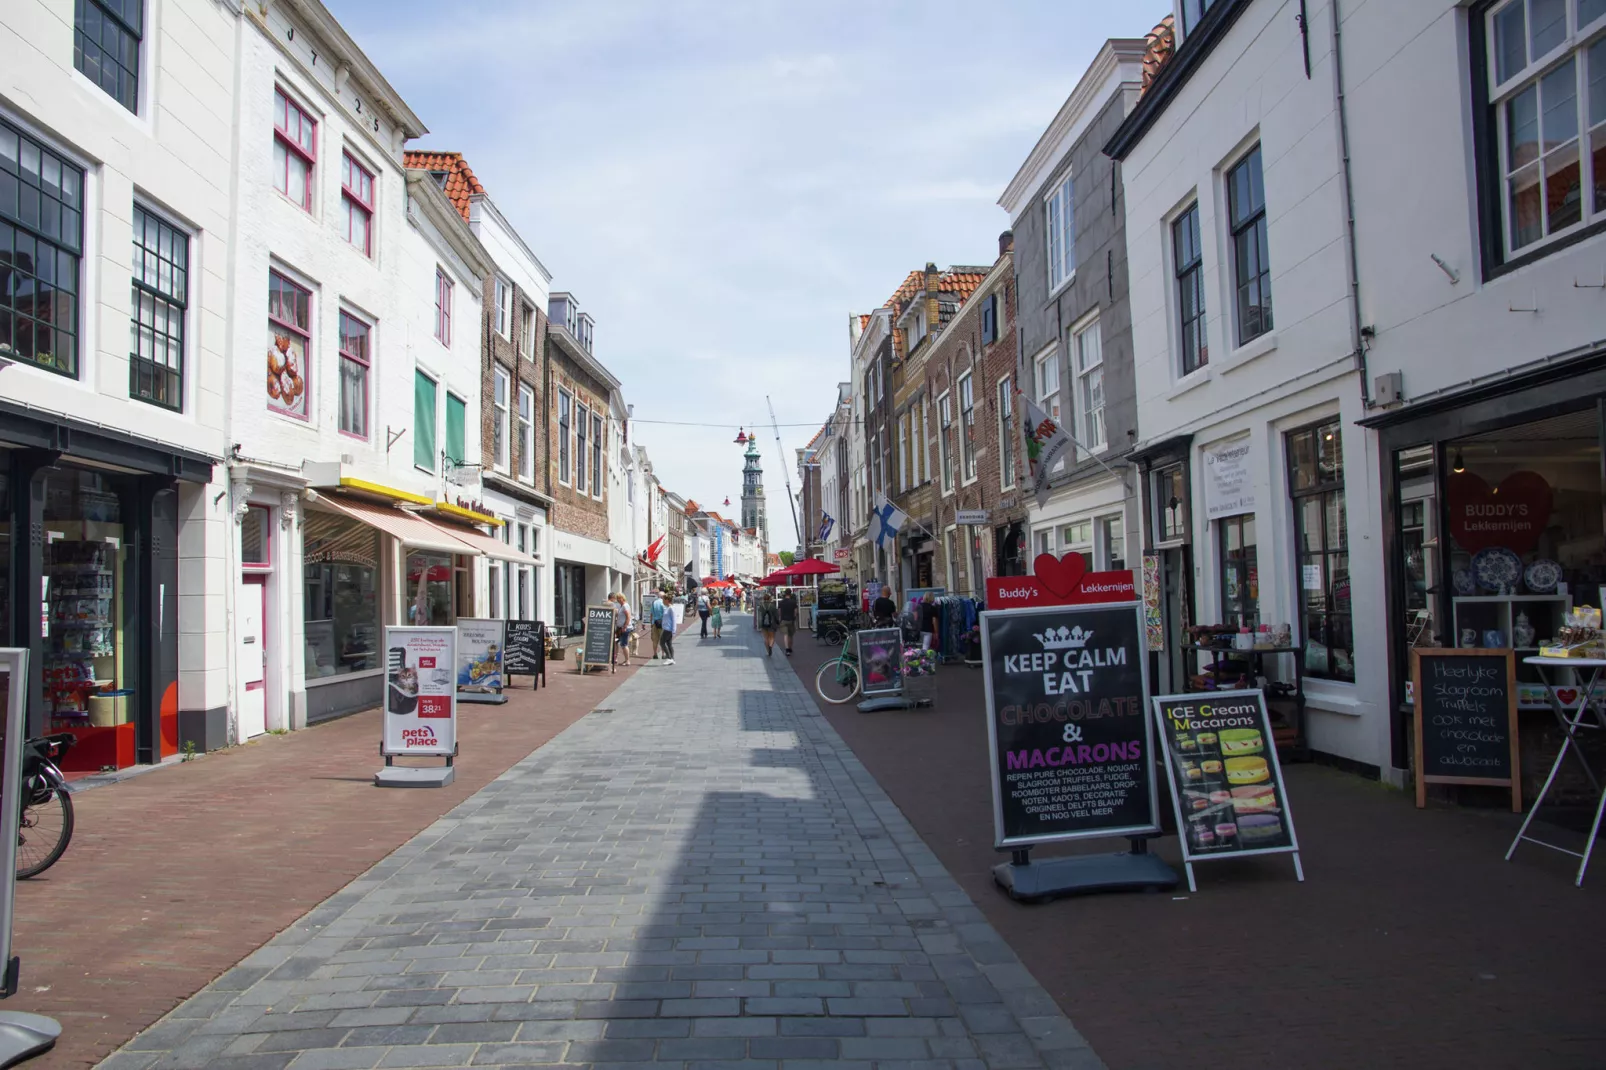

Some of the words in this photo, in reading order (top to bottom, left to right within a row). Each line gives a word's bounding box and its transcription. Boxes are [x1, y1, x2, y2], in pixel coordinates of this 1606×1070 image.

[1465, 503, 1529, 517] BUDDY'S
[1464, 520, 1532, 533] Lekkernijen
[998, 587, 1039, 600] Buddy's
[1080, 581, 1135, 594] Lekkernijen
[589, 610, 612, 619] BMK
[1004, 652, 1057, 674] KEEP
[1063, 647, 1127, 669] CALM
[1043, 670, 1094, 696] EAT
[1000, 696, 1140, 726] CHOCOLATE
[1167, 706, 1195, 720] ICE
[1200, 704, 1256, 717] Cream
[1174, 716, 1254, 731] Macarons
[402, 728, 428, 740] pets
[1062, 723, 1083, 742] &
[406, 737, 438, 748] place
[1456, 743, 1477, 753] en
[1006, 740, 1141, 770] MACARONS
[1006, 772, 1033, 782] REPEN
[1034, 770, 1055, 779] PURE
[1017, 778, 1061, 789] SLAGROOM
[1011, 786, 1060, 798] ROOMBOTER
[1025, 803, 1066, 814] ORIGINEEL
[1067, 800, 1097, 810] DELFTS
[1097, 798, 1125, 807] BLAUW
[1040, 813, 1051, 821] EN
[1052, 812, 1069, 820] NOG
[1070, 809, 1091, 818] VEEL
[1091, 807, 1114, 816] MEER
